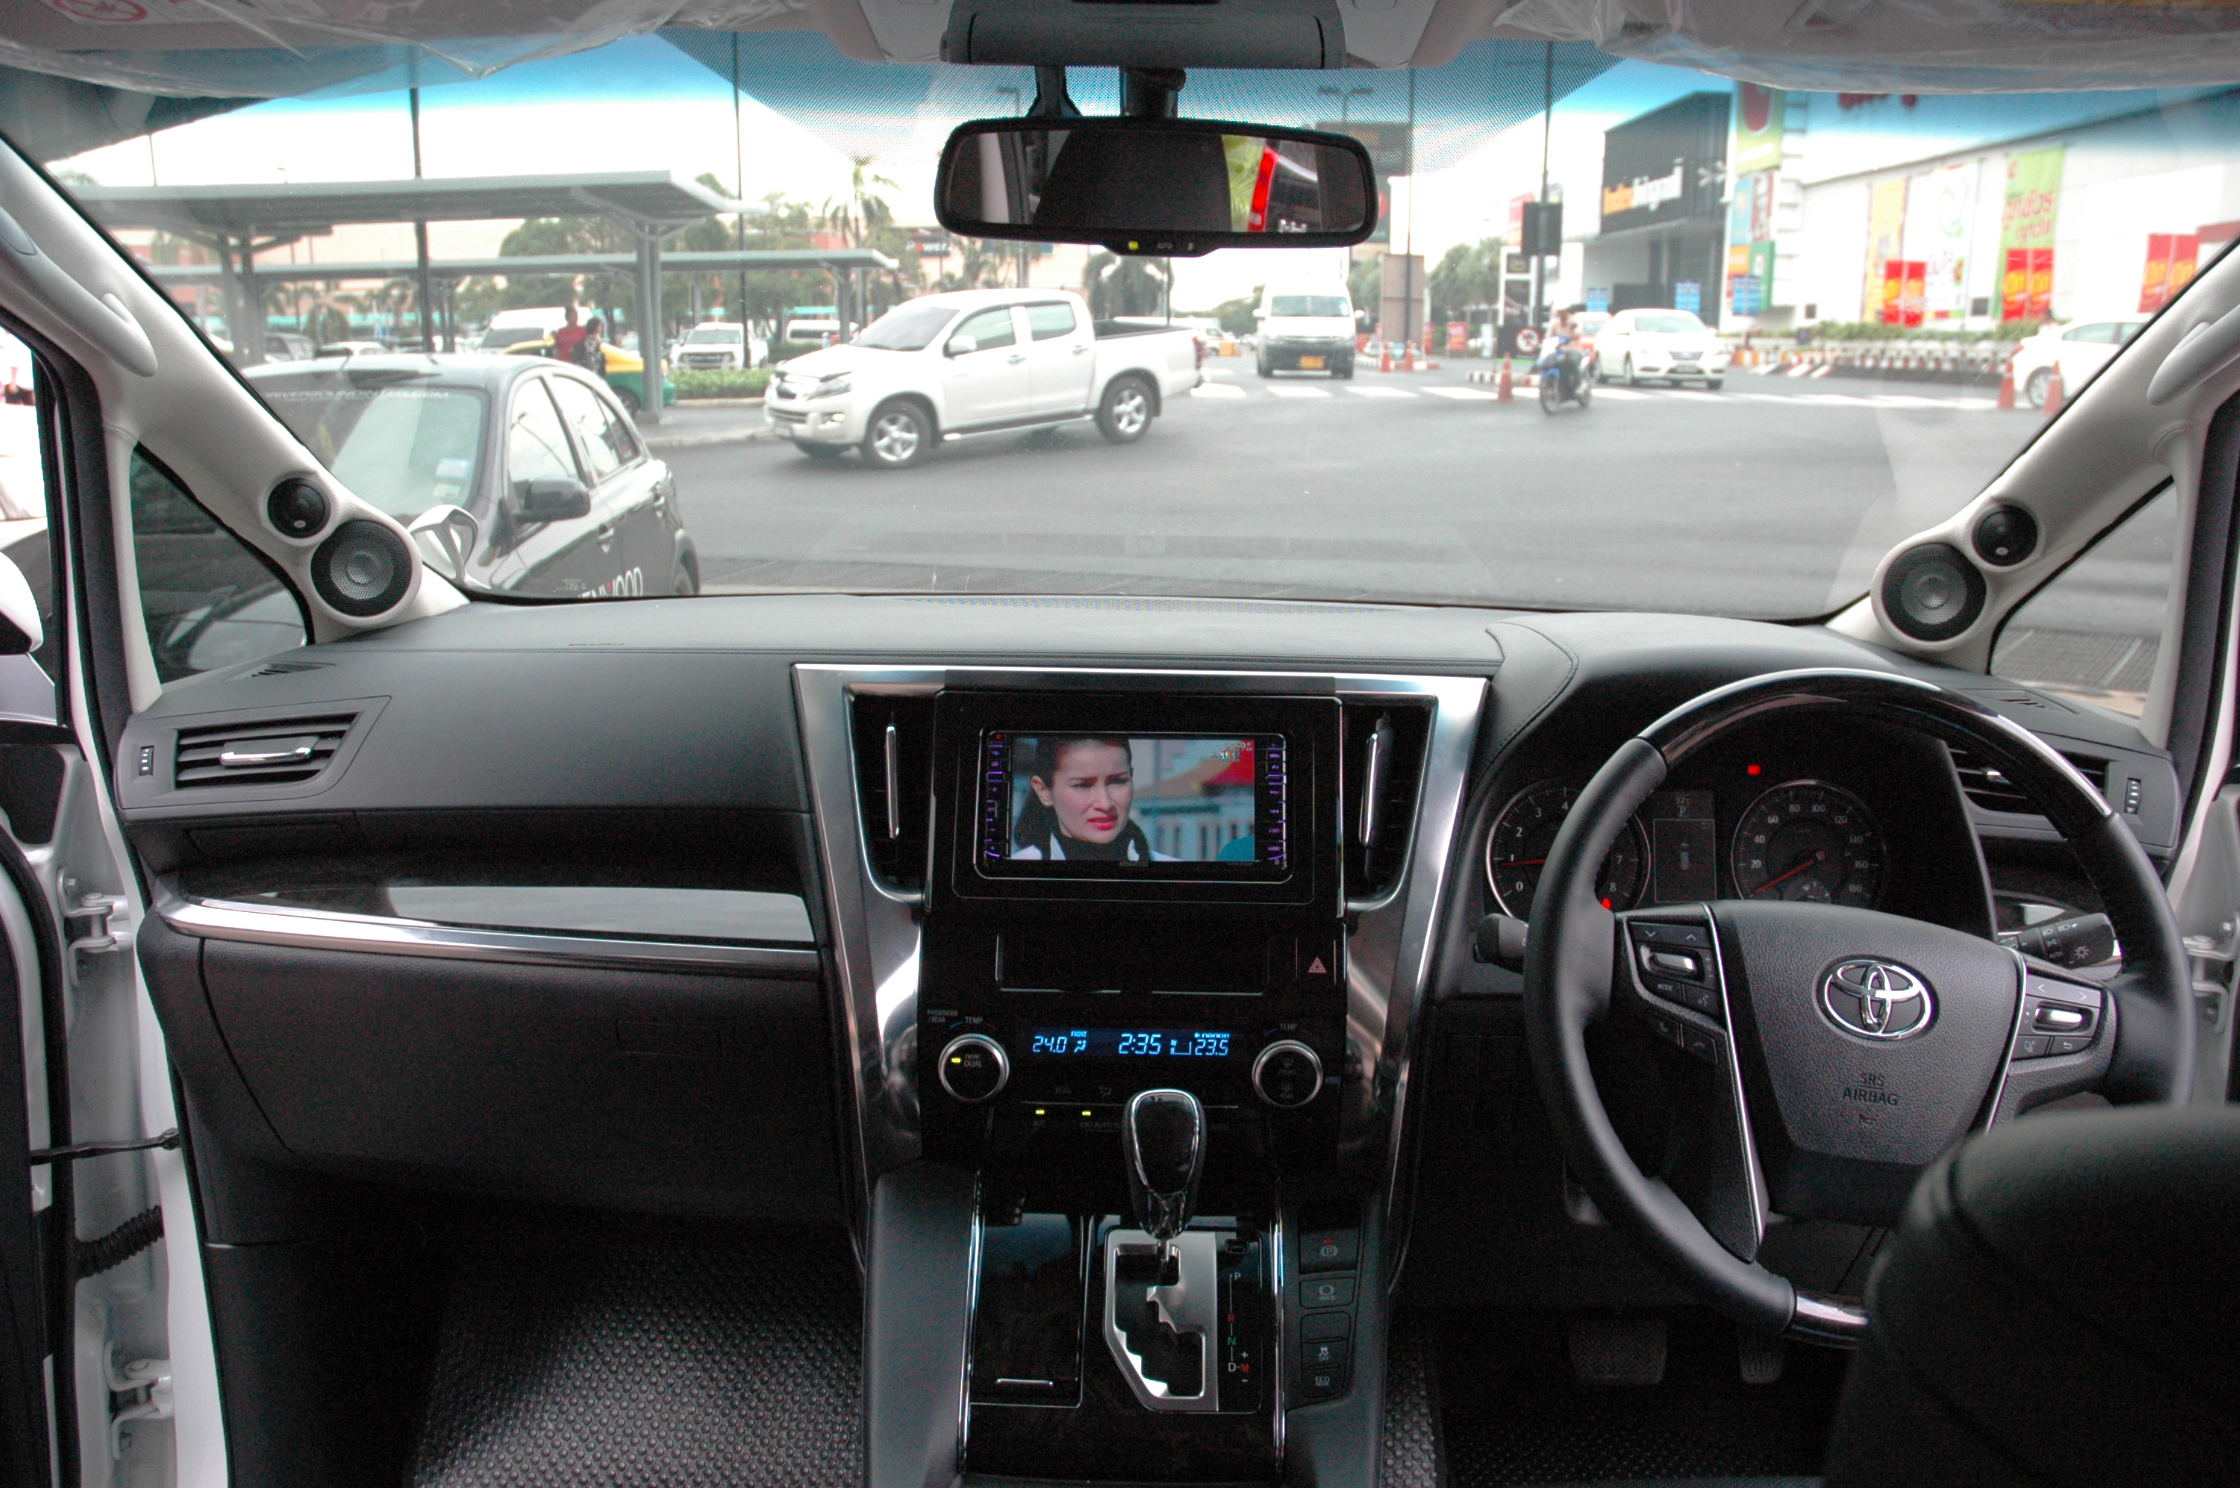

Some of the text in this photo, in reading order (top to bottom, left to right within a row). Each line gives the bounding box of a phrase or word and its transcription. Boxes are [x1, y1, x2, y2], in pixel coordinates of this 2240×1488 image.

[1535, 807, 1542, 818] 3
[1789, 803, 1800, 812] 80
[1812, 803, 1826, 812] 100
[1768, 814, 1778, 824] 60
[1834, 815, 1847, 824] 120
[1516, 827, 1523, 838] 2
[1754, 835, 1766, 844] 40
[1849, 836, 1863, 845] 140
[1616, 855, 1623, 865] 7
[1751, 859, 1762, 869] 20
[1855, 860, 1868, 869] 160
[1516, 882, 1523, 892] 0
[1609, 882, 1617, 892] 8
[1848, 883, 1861, 893] 180
[965, 1016, 983, 1025] TEMP
[1032, 1035, 1067, 1054] 24.0
[1118, 1033, 1161, 1055] 2:35
[1195, 1039, 1229, 1056] 23.5
[1860, 1073, 1885, 1087] SRS
[1843, 1087, 1898, 1106] AIRBAG
[1233, 1271, 1242, 1281] P
[1227, 1313, 1236, 1323] R
[1227, 1336, 1237, 1346] N
